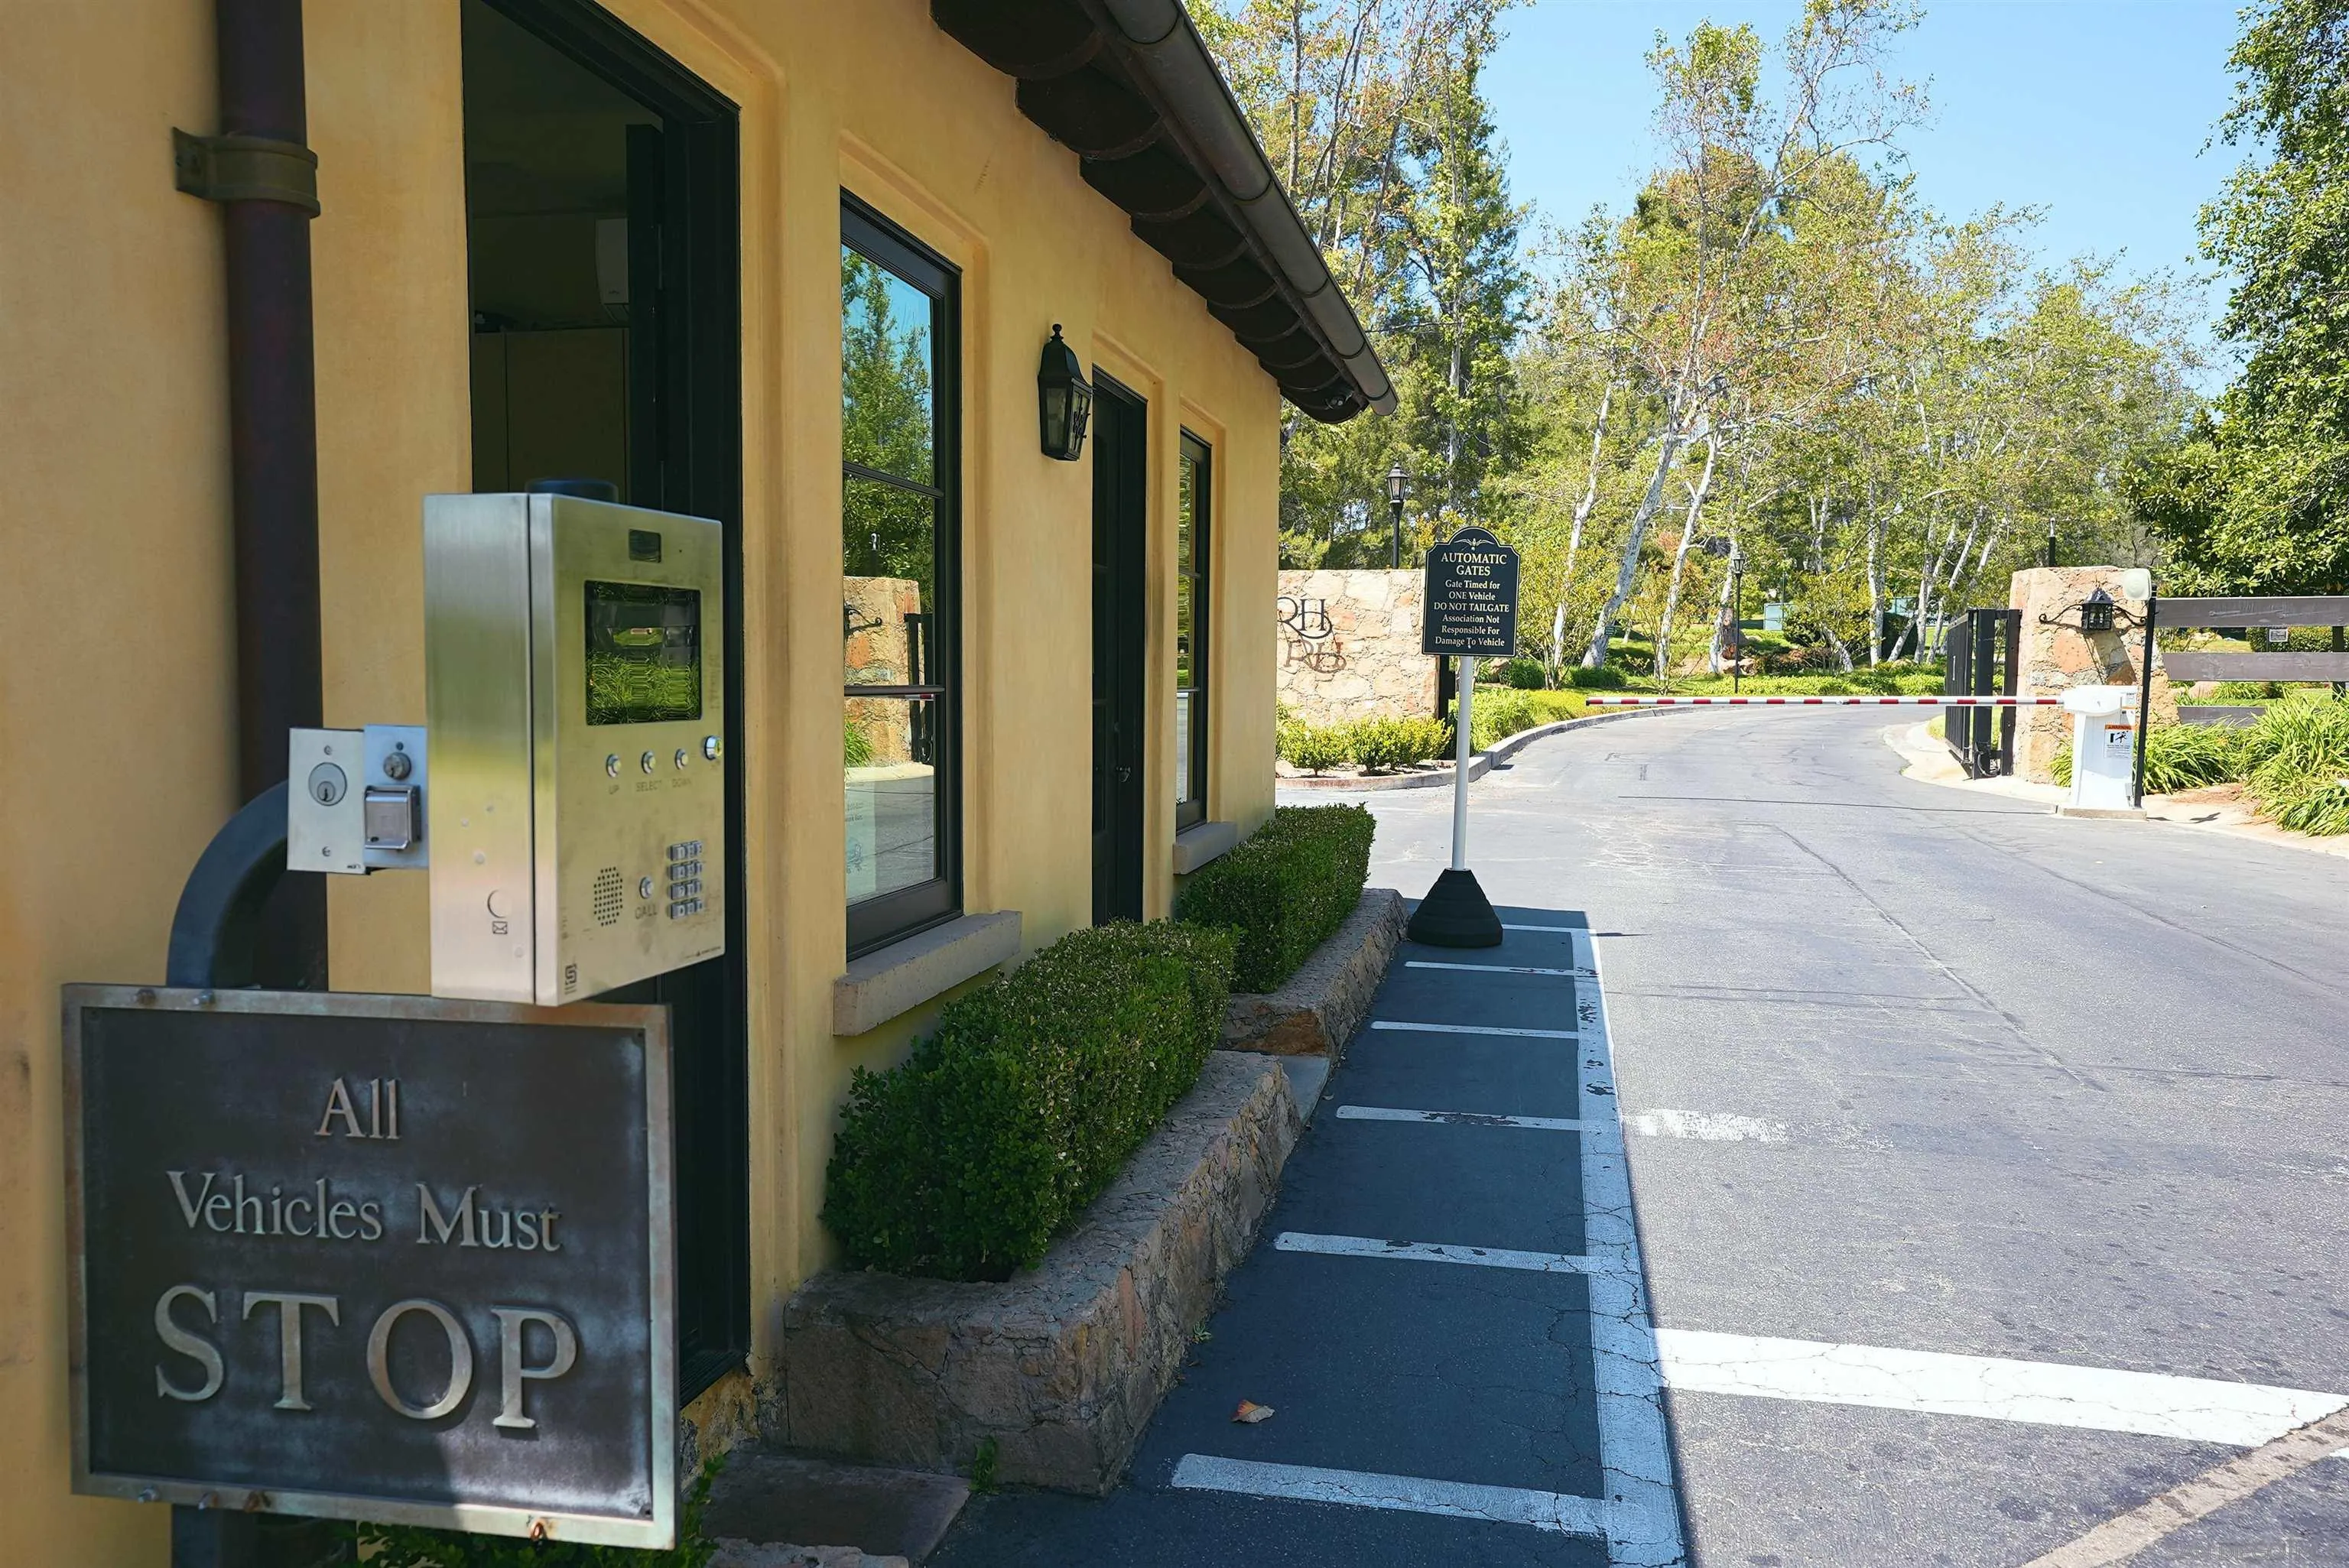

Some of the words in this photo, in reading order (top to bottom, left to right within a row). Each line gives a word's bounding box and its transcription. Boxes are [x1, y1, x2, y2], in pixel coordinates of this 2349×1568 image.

[1441, 552, 1507, 565] AUTOMATIC
[1456, 565, 1490, 576] GATES
[1445, 579, 1463, 589] Gate
[1464, 580, 1488, 589] Timed
[1489, 581, 1500, 589] for
[1434, 602, 1447, 611] DO
[1448, 602, 1467, 611] NOT
[1468, 603, 1509, 612] TAILGATE
[1442, 614, 1484, 623] Association
[1486, 615, 1499, 624] Not
[1441, 625, 1486, 635] Responsible
[1487, 626, 1500, 635] For
[1435, 636, 1465, 646] Damage
[1466, 637, 1477, 645] To
[1477, 638, 1505, 647] Vehicle
[314, 1077, 401, 1141] All
[165, 1170, 384, 1242] Vehicles
[415, 1182, 563, 1252] Must
[153, 1284, 578, 1431] STOP
